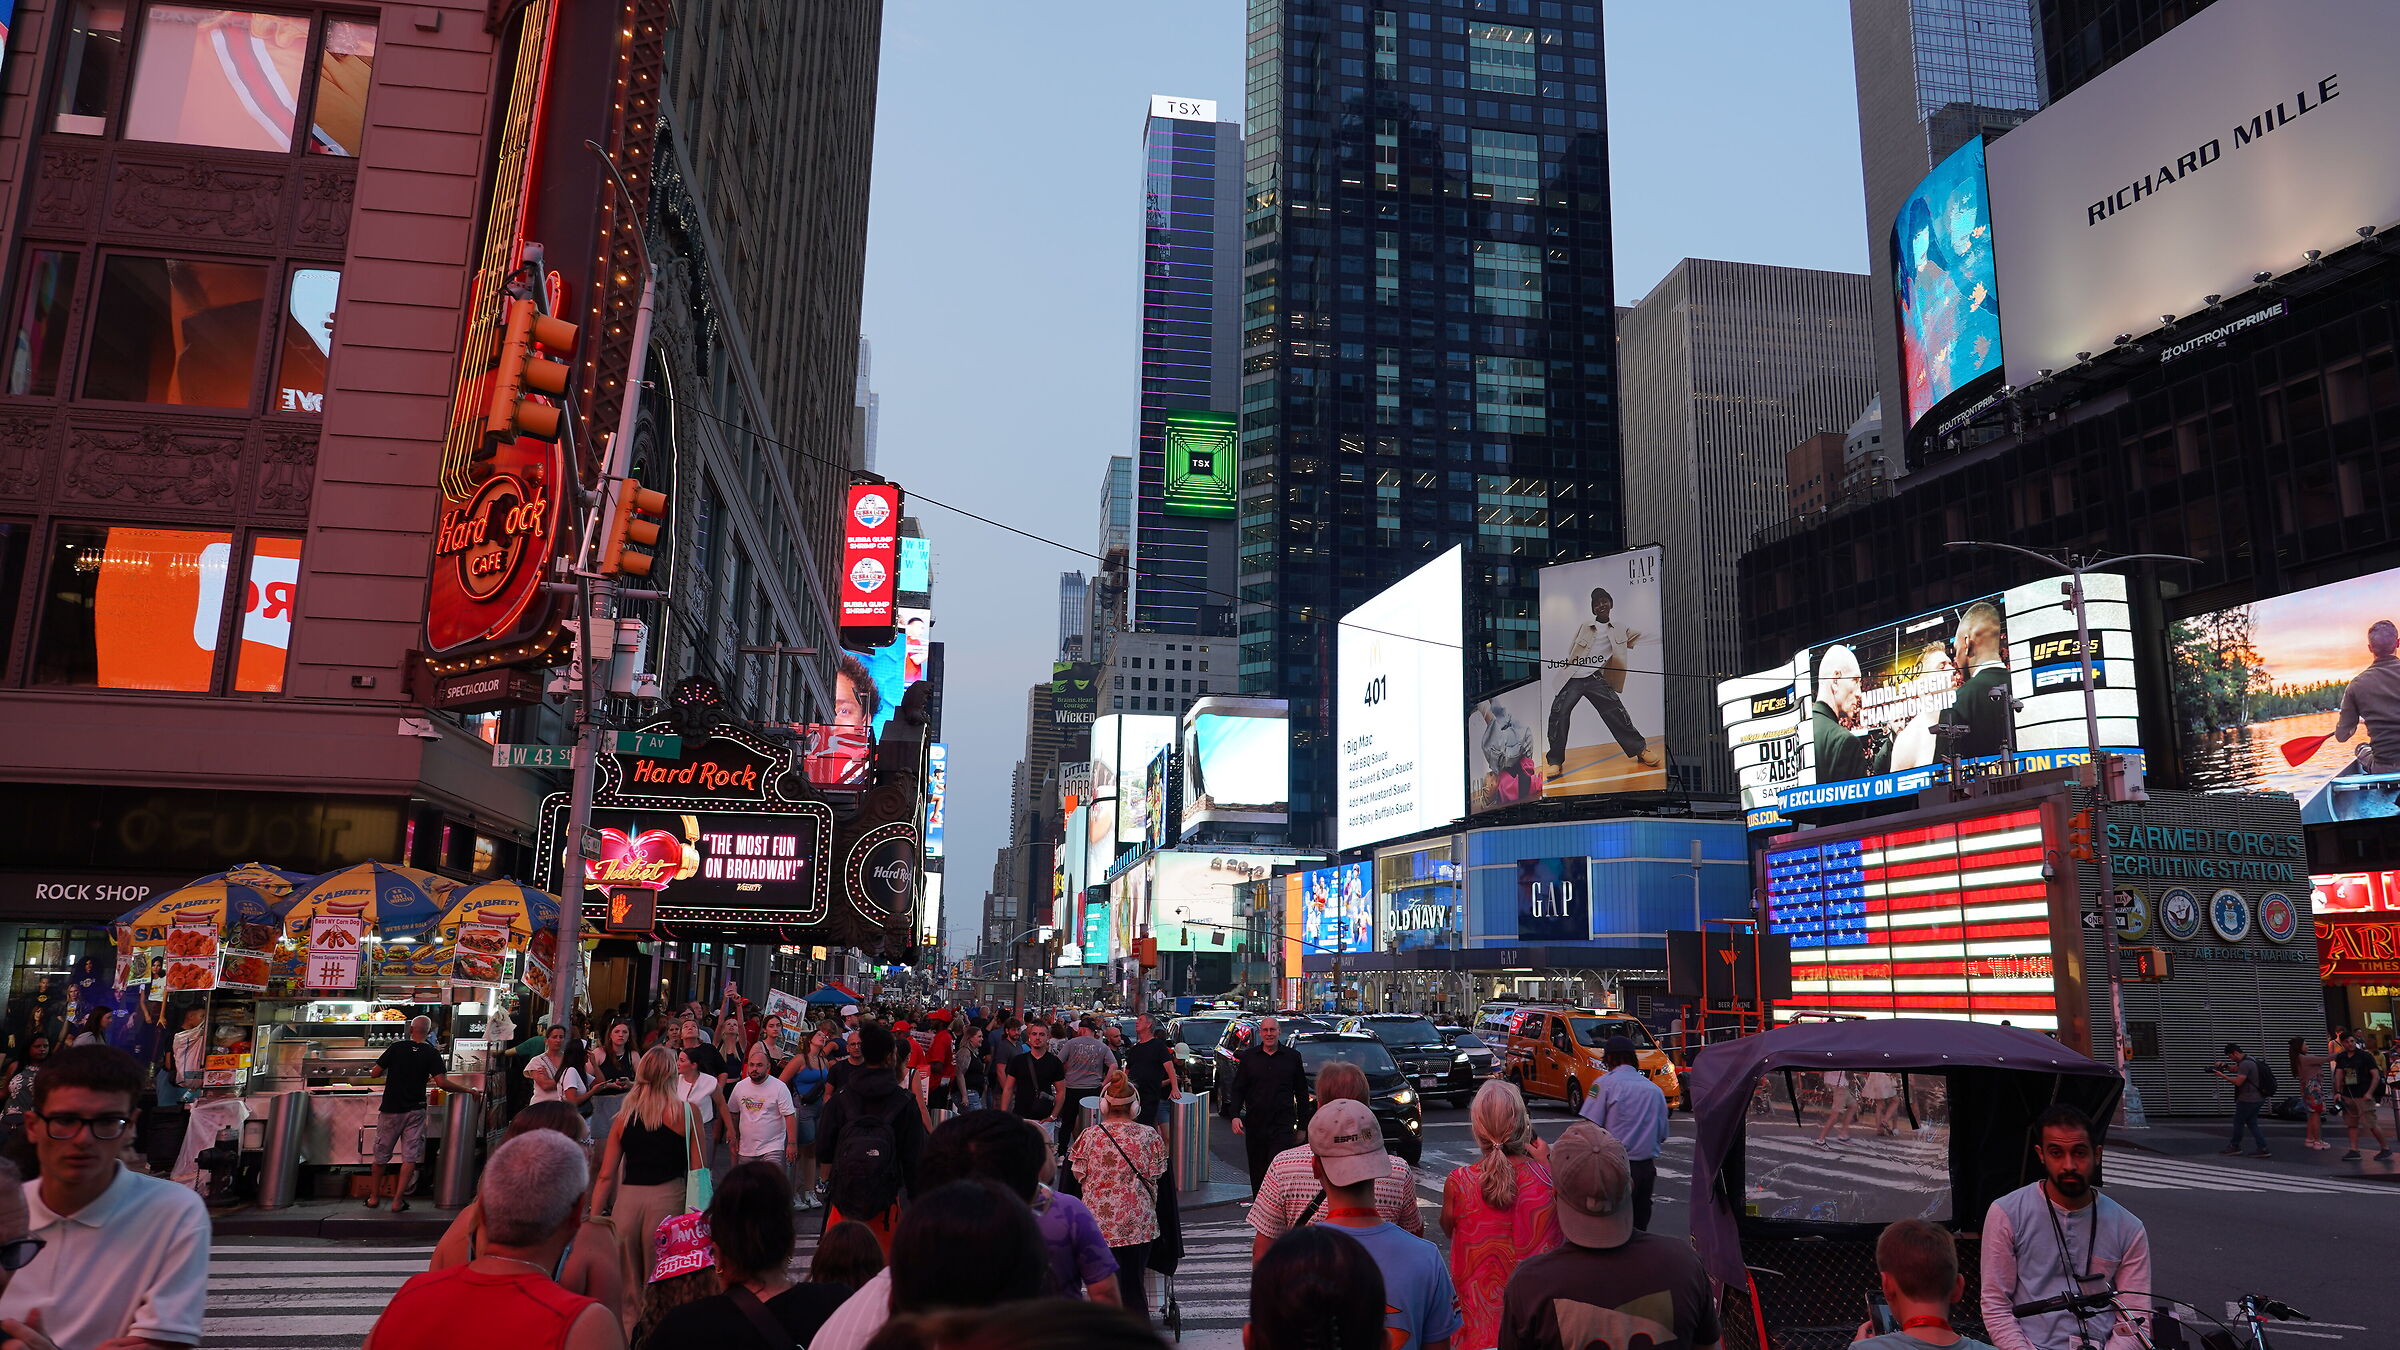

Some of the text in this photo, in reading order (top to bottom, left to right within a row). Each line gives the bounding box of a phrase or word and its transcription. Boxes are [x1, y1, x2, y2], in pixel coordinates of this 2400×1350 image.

[1168, 101, 1201, 116] TSX
[2087, 73, 2340, 227] RICHARD MILLE
[2160, 302, 2284, 364] #OUTFRONTPRIME
[1192, 459, 1210, 468] TSX
[437, 501, 493, 556] Hard
[471, 552, 503, 577] CAFE
[1629, 555, 1655, 579] GAP
[1629, 577, 1655, 586] KIDS
[2033, 639, 2098, 661] UFC 35
[1547, 655, 1607, 670] Just dance.
[446, 678, 500, 699] SPECTACOLOR
[1364, 674, 1387, 707] 401
[1861, 671, 1954, 708] MIDDLEWEIGHT
[1753, 699, 1776, 714] UFC
[1860, 690, 1957, 727] CHAMPIONSHIP
[635, 735, 665, 752] 7 Av
[1347, 741, 1358, 756] Big
[1359, 734, 1373, 748] Mac
[1759, 740, 1782, 762] DU
[513, 747, 571, 766] W 43 St
[1349, 750, 1388, 772] Add BBQ Sauce
[2026, 754, 2051, 773] ON
[634, 759, 757, 791] Hard Rock
[1065, 763, 1090, 779] LITTLE
[1349, 778, 1359, 790] Add
[1359, 774, 1376, 788] Sweet
[1381, 767, 1395, 780] Sour
[1395, 760, 1413, 775] Sauce
[1349, 781, 1411, 808] Add Hot Mustard Sauce
[1789, 771, 1930, 808] EXCLUSIVELY ON ESPN
[1349, 801, 1413, 827] Add Spicy Buffalo Sauce
[741, 834, 770, 856] MOST
[772, 836, 796, 857] FUN
[2129, 825, 2301, 858] ARMED FORCES
[596, 857, 678, 882] Juliet
[705, 859, 722, 878] ON
[873, 866, 900, 879] Hard
[2219, 860, 2294, 881] STATION
[35, 883, 150, 901] ROCK SHOP
[311, 888, 372, 905] SABRETT
[1531, 881, 1574, 918] GAP
[159, 898, 222, 914] SABRETT
[462, 899, 520, 913] SABRETT
[1389, 905, 1446, 931] OLD NAVY
[2088, 916, 2102, 925] ONE
[1500, 950, 1517, 965] GAP
[2194, 947, 2211, 959] AIR
[2215, 949, 2250, 961] FORCE
[2260, 950, 2304, 962] MARINES
[2359, 961, 2399, 971] TIMES
[1334, 1134, 1358, 1143] ESPN
